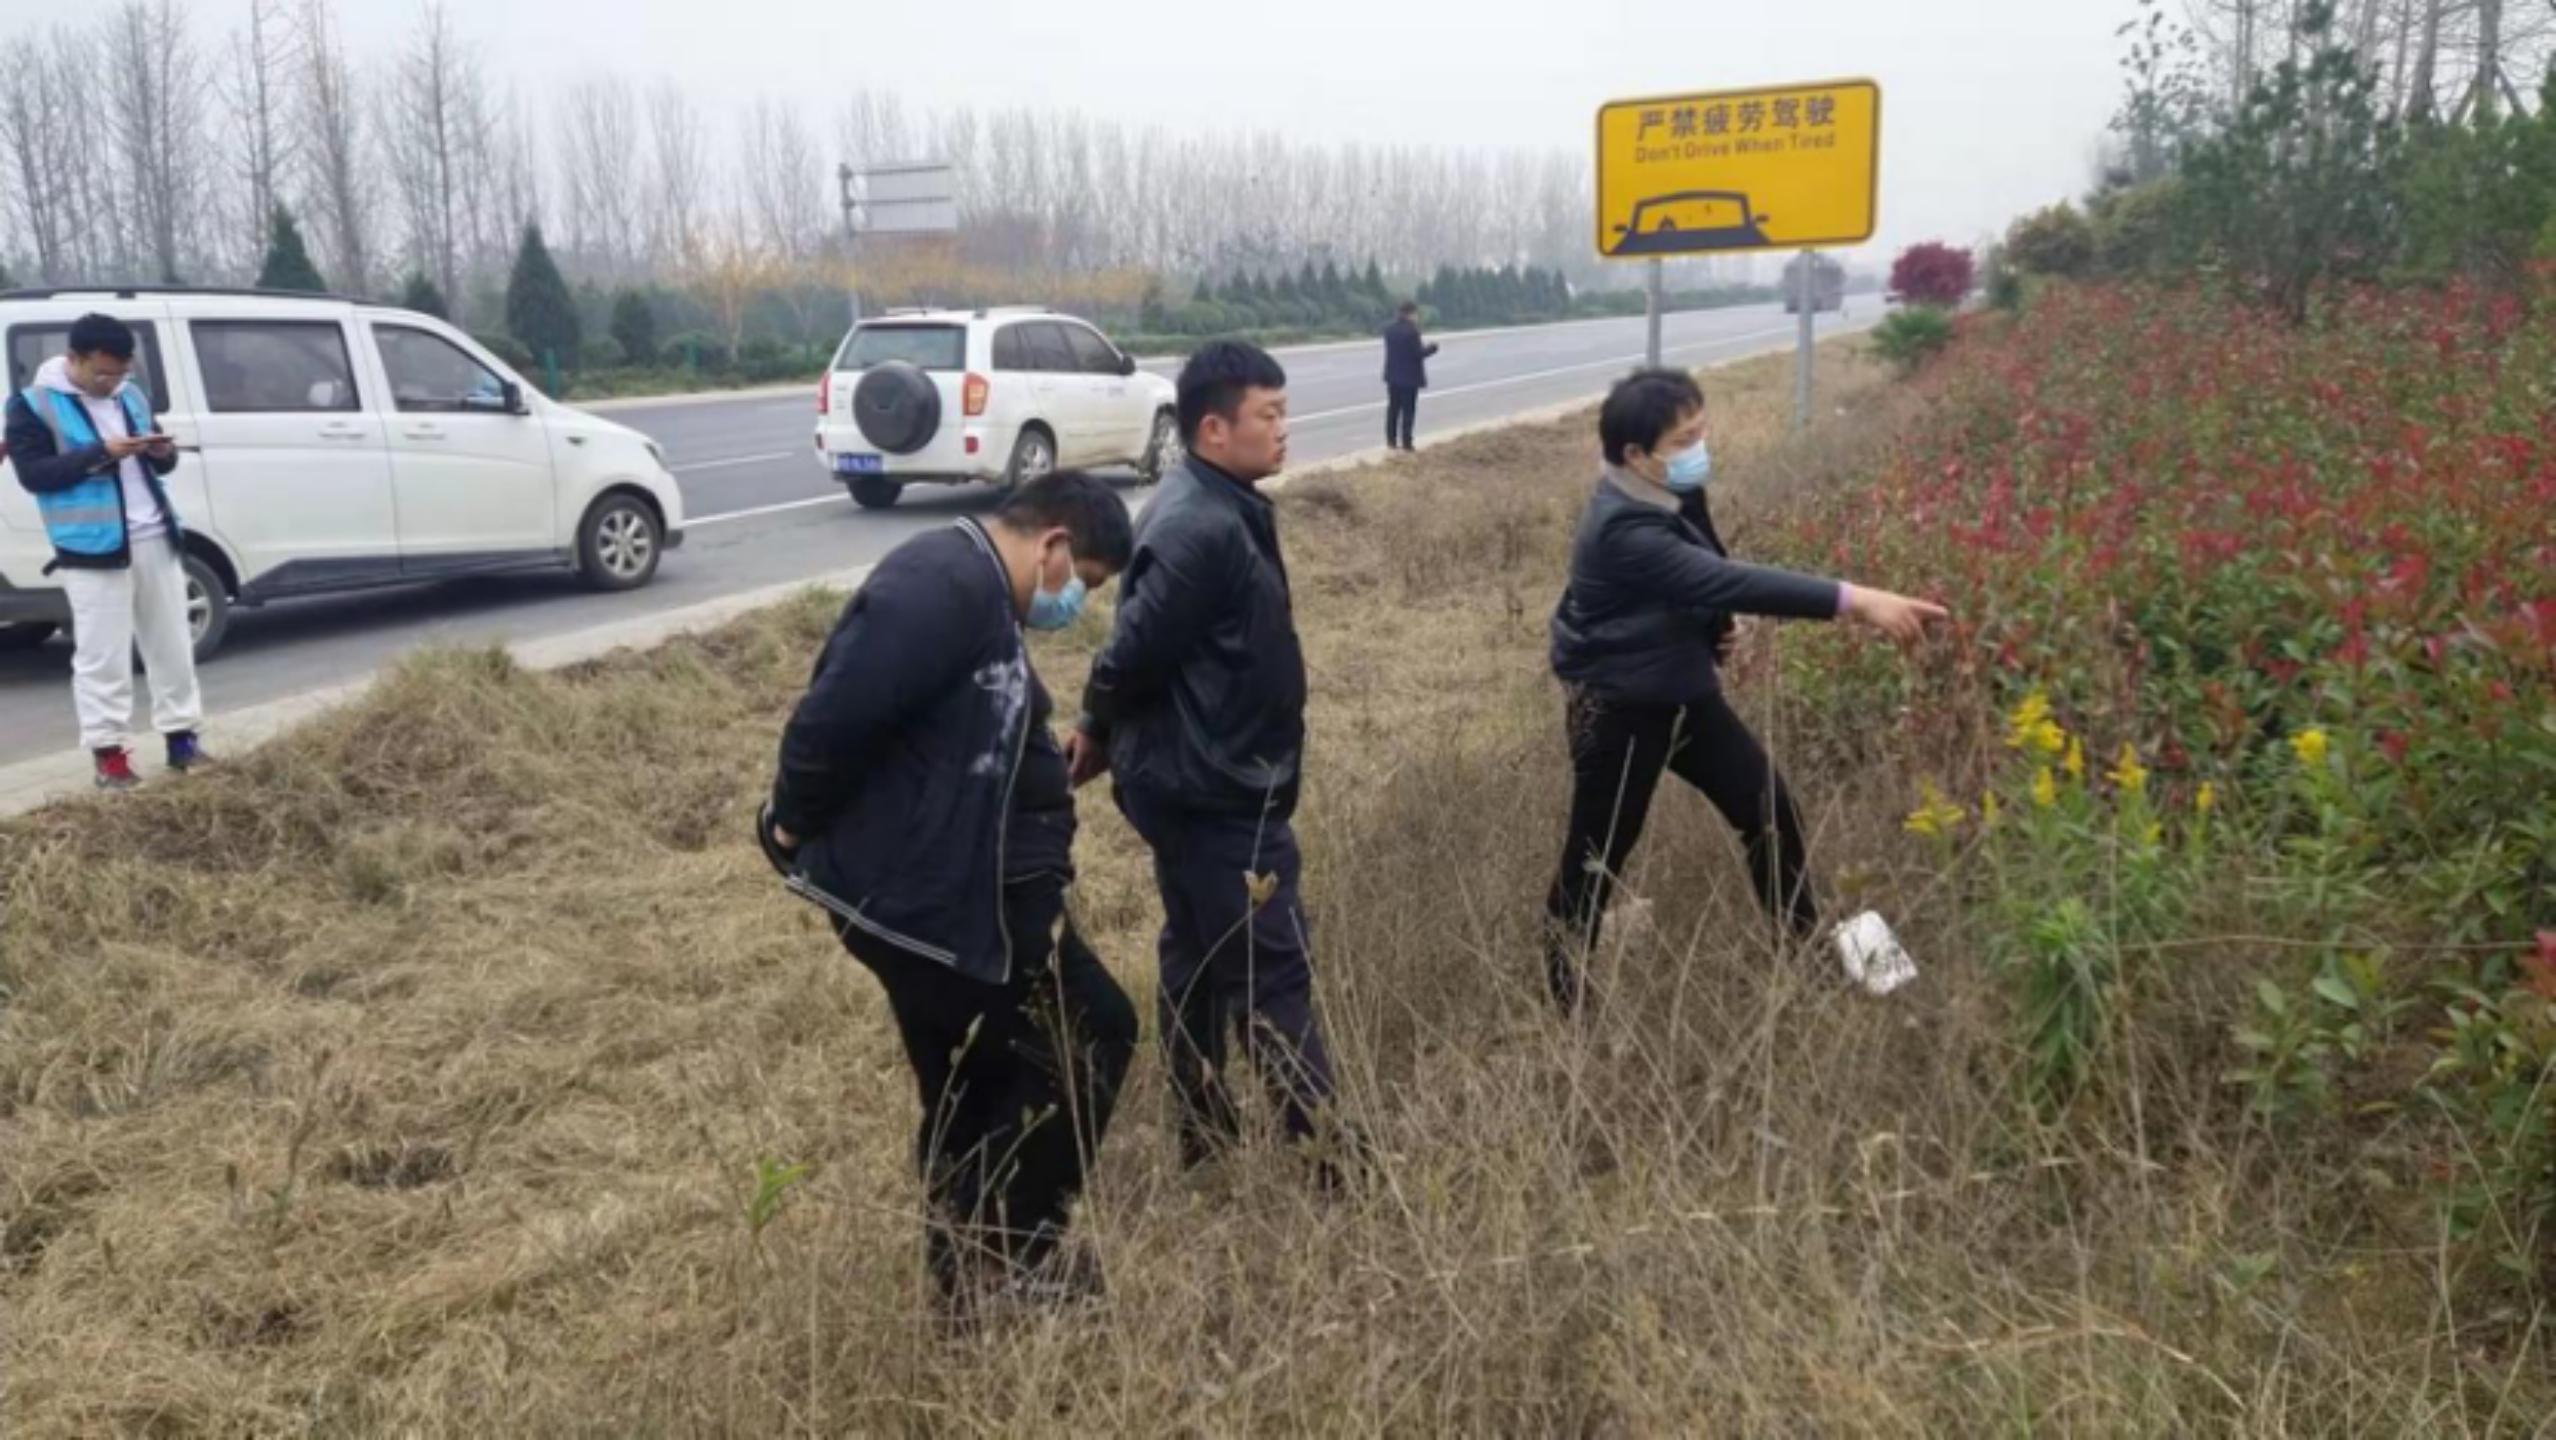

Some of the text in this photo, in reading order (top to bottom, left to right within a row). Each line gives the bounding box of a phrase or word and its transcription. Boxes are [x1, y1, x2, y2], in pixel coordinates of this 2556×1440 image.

[1637, 95, 1836, 140] 严禁疲劳驾驶
[1635, 132, 1835, 163] Don't Drive When Tired
